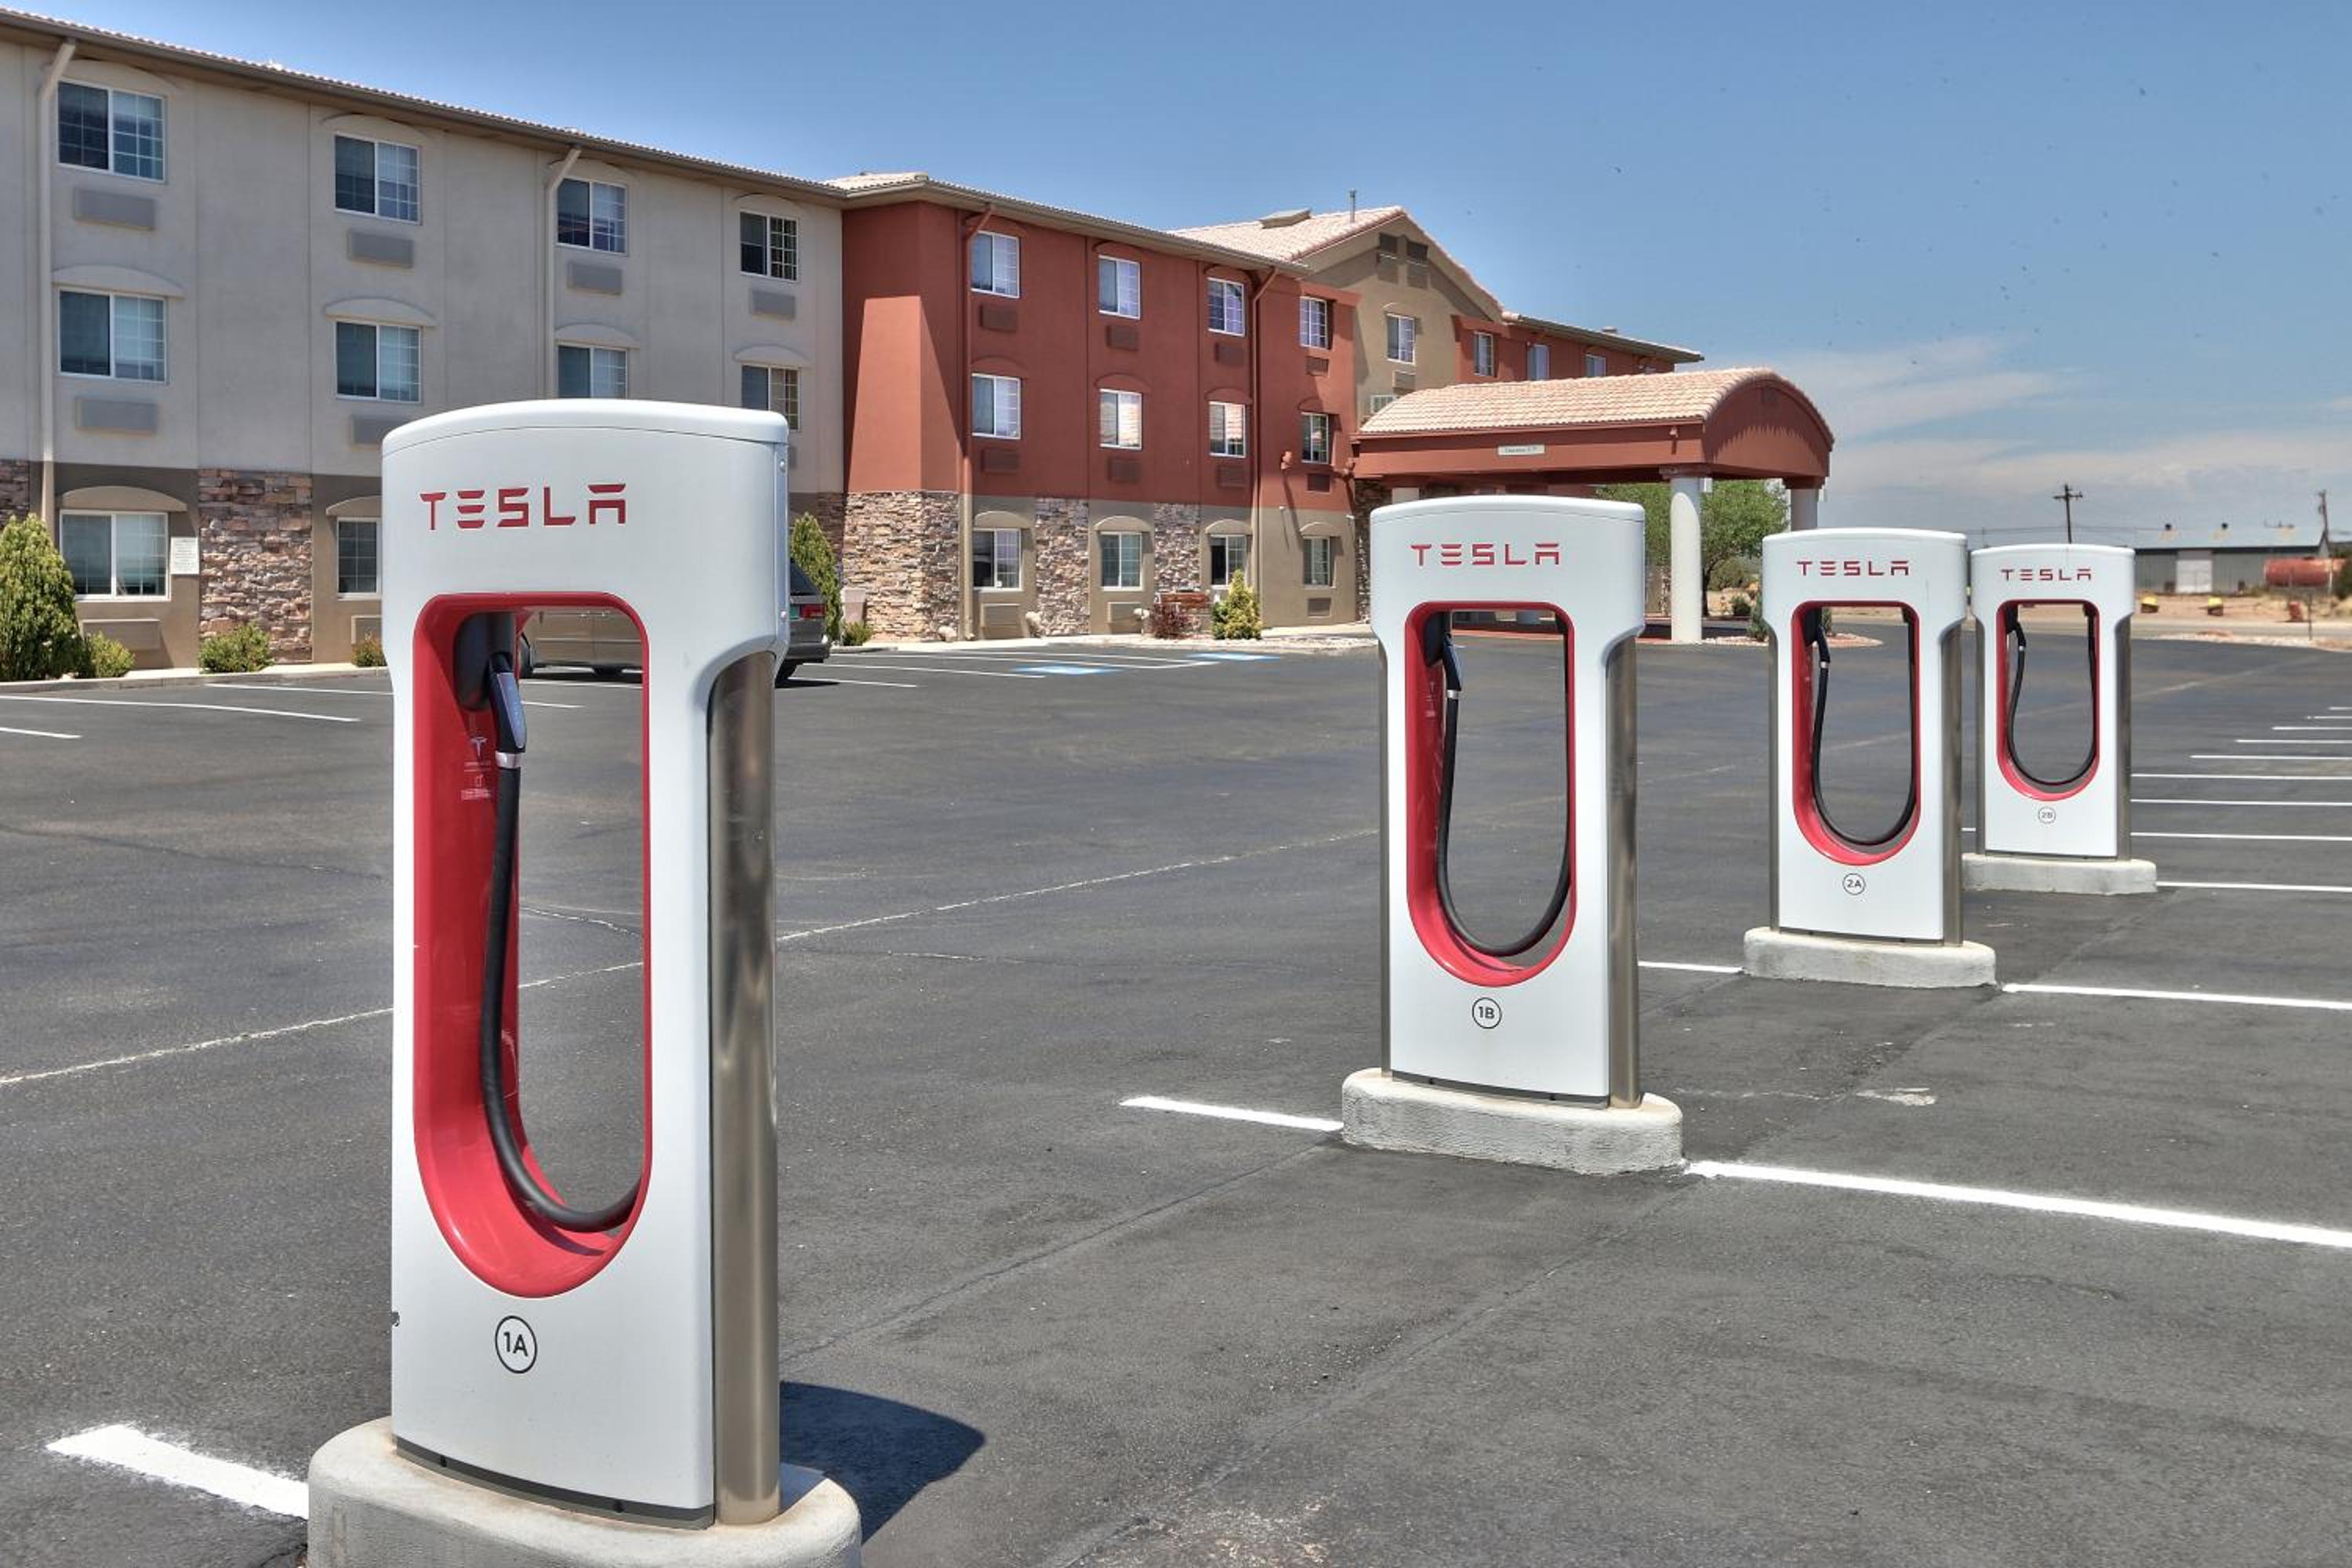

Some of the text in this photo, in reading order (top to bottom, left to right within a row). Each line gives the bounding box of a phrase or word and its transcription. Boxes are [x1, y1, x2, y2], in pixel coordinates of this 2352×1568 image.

[419, 483, 626, 531] TESLA
[1410, 543, 1560, 567] TESLA
[1796, 560, 1910, 577] TESLA
[2001, 568, 2092, 582] TESLA
[1846, 879, 1862, 889] 2A
[1478, 1006, 1495, 1020] 1B
[503, 1331, 528, 1357] 1A
